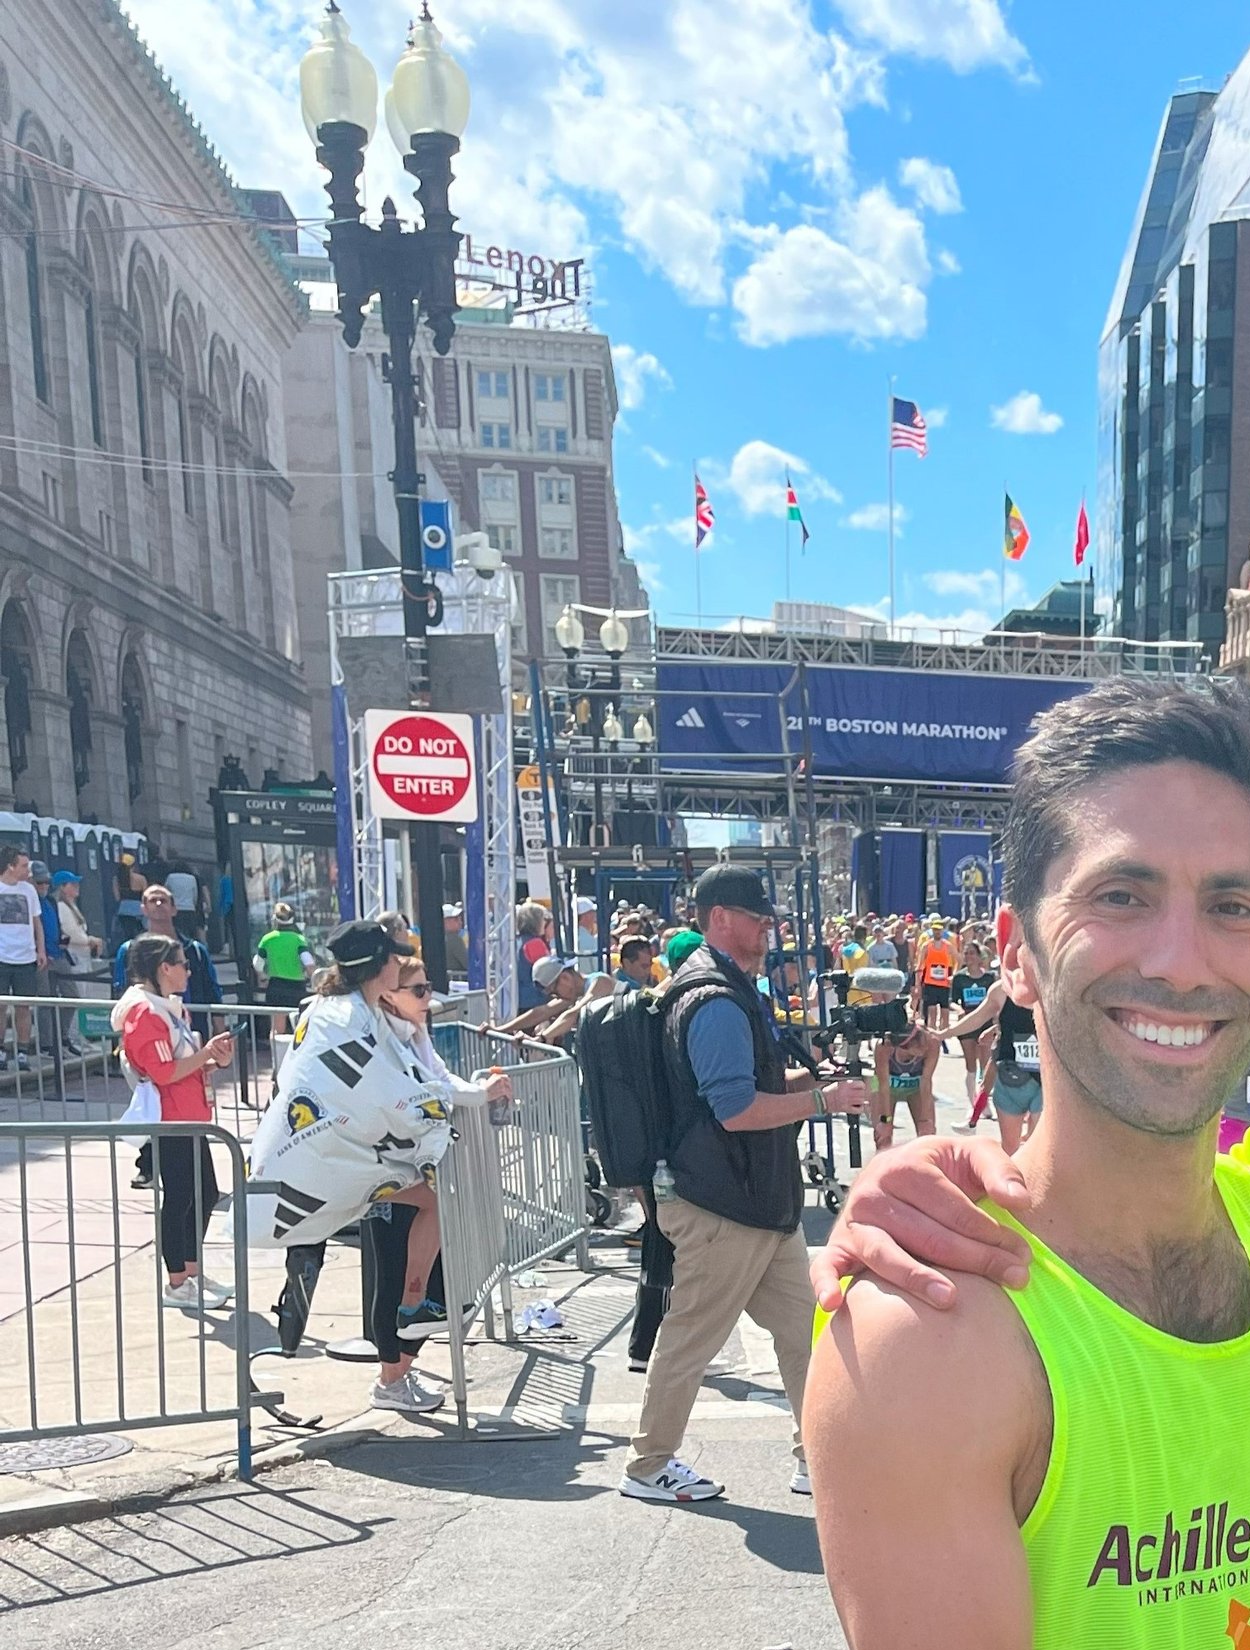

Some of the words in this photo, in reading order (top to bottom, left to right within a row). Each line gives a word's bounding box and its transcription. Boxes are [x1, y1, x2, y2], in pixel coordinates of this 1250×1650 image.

[826, 717, 898, 736] BOSTON
[384, 736, 413, 753] DO
[419, 738, 458, 756] NOT
[393, 777, 455, 796] ENTER
[246, 799, 287, 810] COPLEY
